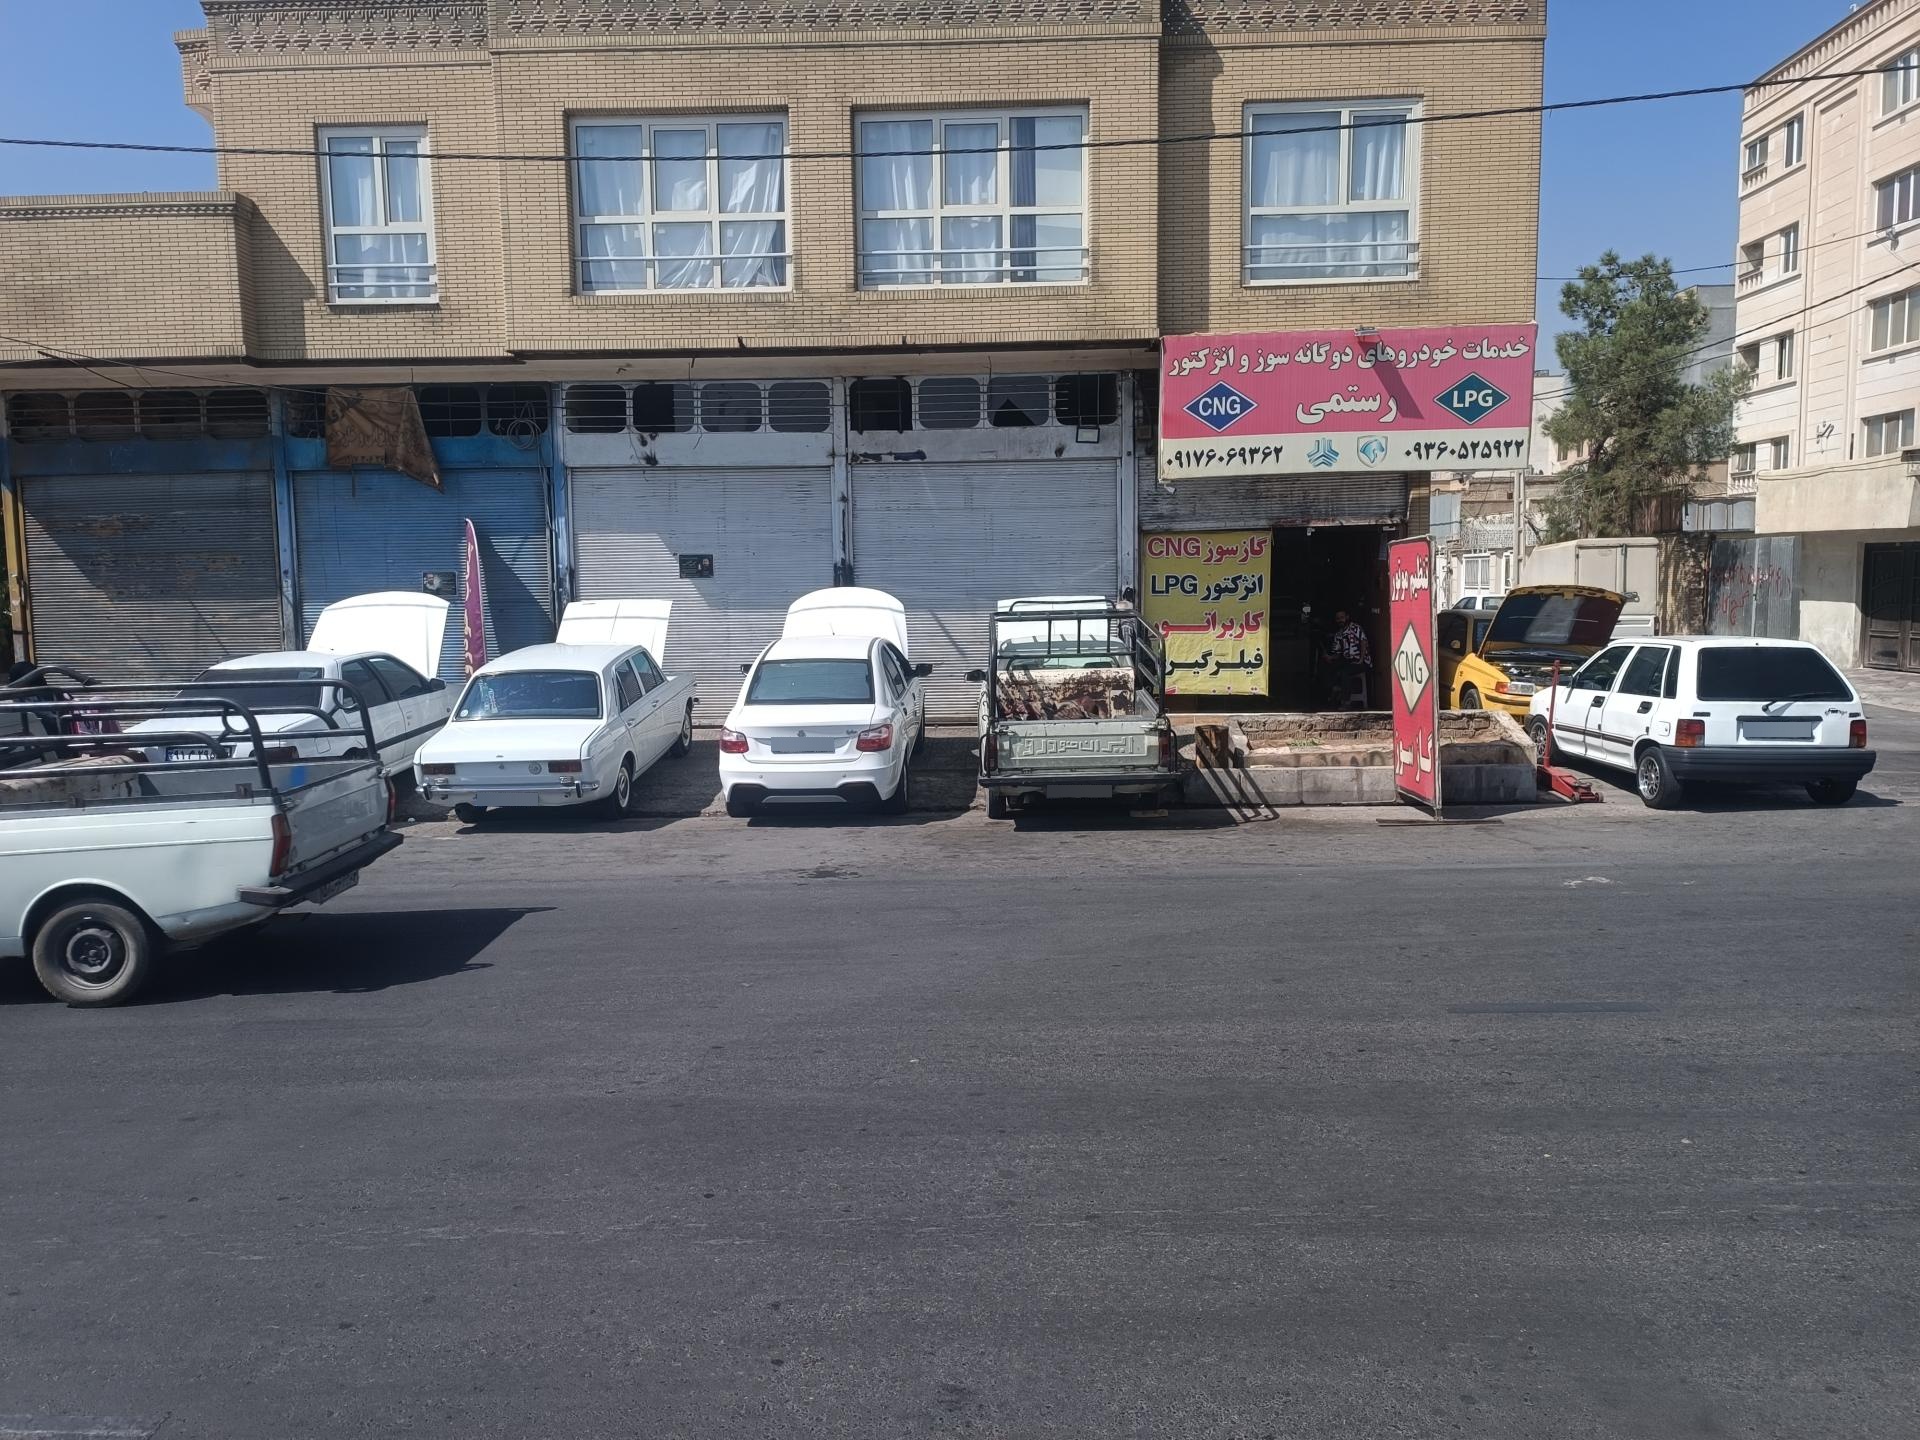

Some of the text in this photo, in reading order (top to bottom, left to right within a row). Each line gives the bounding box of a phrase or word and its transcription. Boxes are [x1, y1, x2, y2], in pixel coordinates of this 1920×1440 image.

[1462, 336, 1530, 360] خدمات
[1168, 345, 1235, 376] انژکتور
[1237, 352, 1250, 374] و
[1252, 348, 1290, 373] سوز
[1198, 395, 1241, 417] CNG
[1296, 384, 1398, 425] رستمی
[1452, 389, 1493, 408] LPG
[1166, 445, 1284, 469] ۰۹۱۷۶۰۶۹۳۶۲
[1405, 439, 1525, 461] ۰۹۳۶۰۵۲۵۹۲۲
[1147, 537, 1201, 558] CNG
[1151, 574, 1263, 602] انژکتور LPG
[1397, 650, 1424, 685] CNG
